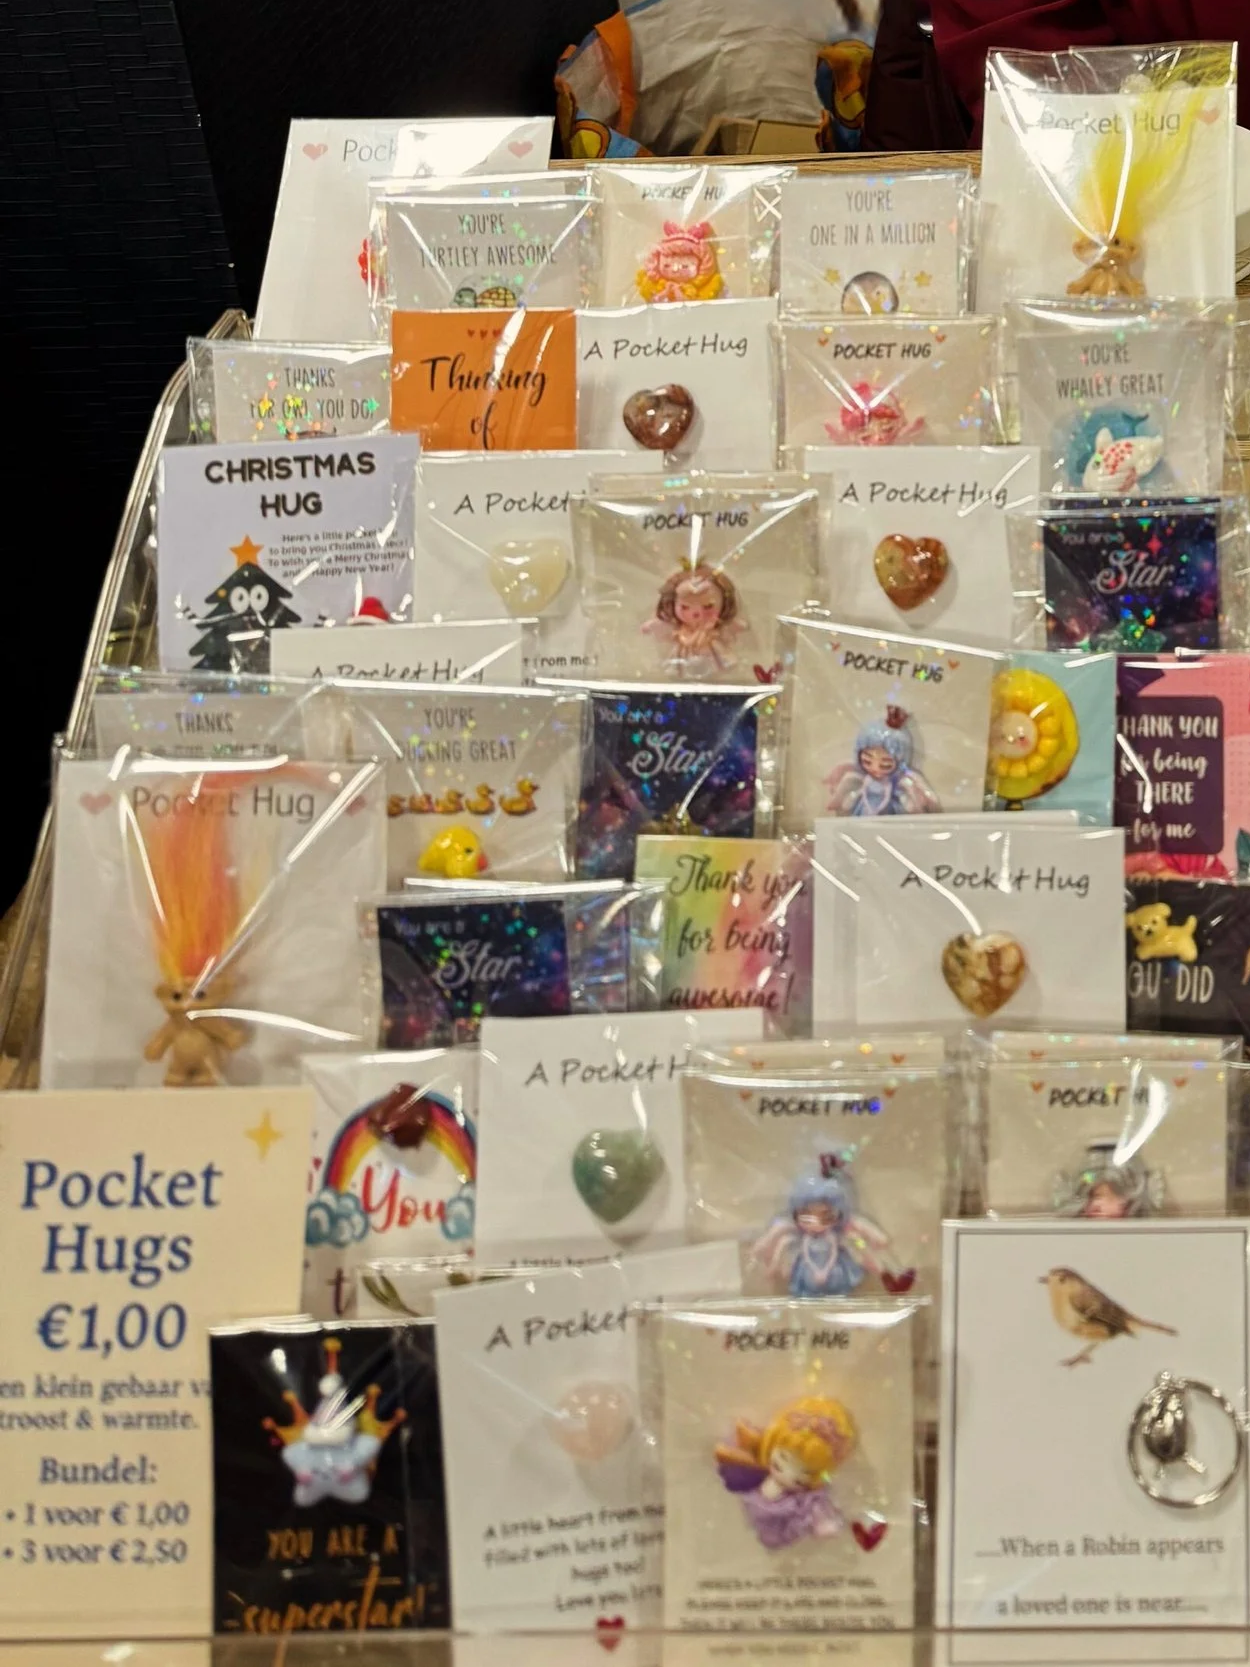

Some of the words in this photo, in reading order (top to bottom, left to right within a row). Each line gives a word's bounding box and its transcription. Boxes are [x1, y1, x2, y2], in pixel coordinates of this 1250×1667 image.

[845, 189, 894, 213] YOU'RE
[458, 213, 506, 235] YOU'RE
[809, 224, 836, 248] ONE
[844, 224, 859, 247] IN
[866, 224, 875, 246] A
[880, 222, 937, 247] MILLION
[583, 339, 603, 361] A
[613, 336, 700, 359] Pocket
[700, 333, 749, 360] Hug
[833, 342, 897, 360] POCKET
[900, 341, 932, 360] HUG
[284, 366, 337, 389] THANKS
[1056, 375, 1112, 401] WHALEY
[1119, 373, 1165, 396] GREAT
[316, 397, 345, 420] YOU
[470, 399, 499, 451] of
[204, 451, 377, 485] CHRISTMAS
[260, 492, 323, 519] HUG
[453, 494, 475, 516] A
[485, 491, 571, 515] Pocket
[837, 482, 860, 505] A
[868, 481, 960, 505] Pocket
[715, 511, 749, 528] HUG
[843, 650, 906, 676] POCKET
[174, 712, 235, 736] THANKS
[422, 707, 476, 731] YOU'RE
[1178, 715, 1220, 740] YOU
[468, 740, 518, 764] GREAT
[1152, 746, 1209, 779] being
[252, 785, 316, 824] Hug
[1166, 821, 1197, 839] me
[668, 853, 756, 898] Thank
[933, 864, 1029, 891] Pockt
[1035, 866, 1091, 897] Hug
[676, 917, 717, 960] for
[1175, 963, 1215, 1004] DID
[523, 1061, 549, 1087] A
[560, 1058, 656, 1085] Pocket
[758, 1097, 834, 1117] POCKET
[20, 1152, 223, 1211] Pocket
[361, 1163, 448, 1235] You
[40, 1223, 194, 1290] Hugs
[36, 1301, 188, 1360] €1,00
[484, 1324, 512, 1353] A
[523, 1308, 630, 1346] Pocket
[34, 1371, 94, 1399] klein
[100, 1375, 184, 1405] gebaar
[0, 1408, 69, 1431] troost
[75, 1406, 93, 1431] &
[39, 1455, 159, 1485] Bundel:
[43, 1506, 103, 1527] voor
[43, 1544, 103, 1565] voor
[266, 1528, 314, 1561] YOU
[1064, 1540, 1076, 1556] a
[1081, 1534, 1142, 1556] Robin
[1146, 1536, 1226, 1560] appears
[996, 1599, 1008, 1615] a
[1013, 1593, 1068, 1615] loved
[1071, 1597, 1110, 1614] one
[1115, 1592, 1132, 1614] is
